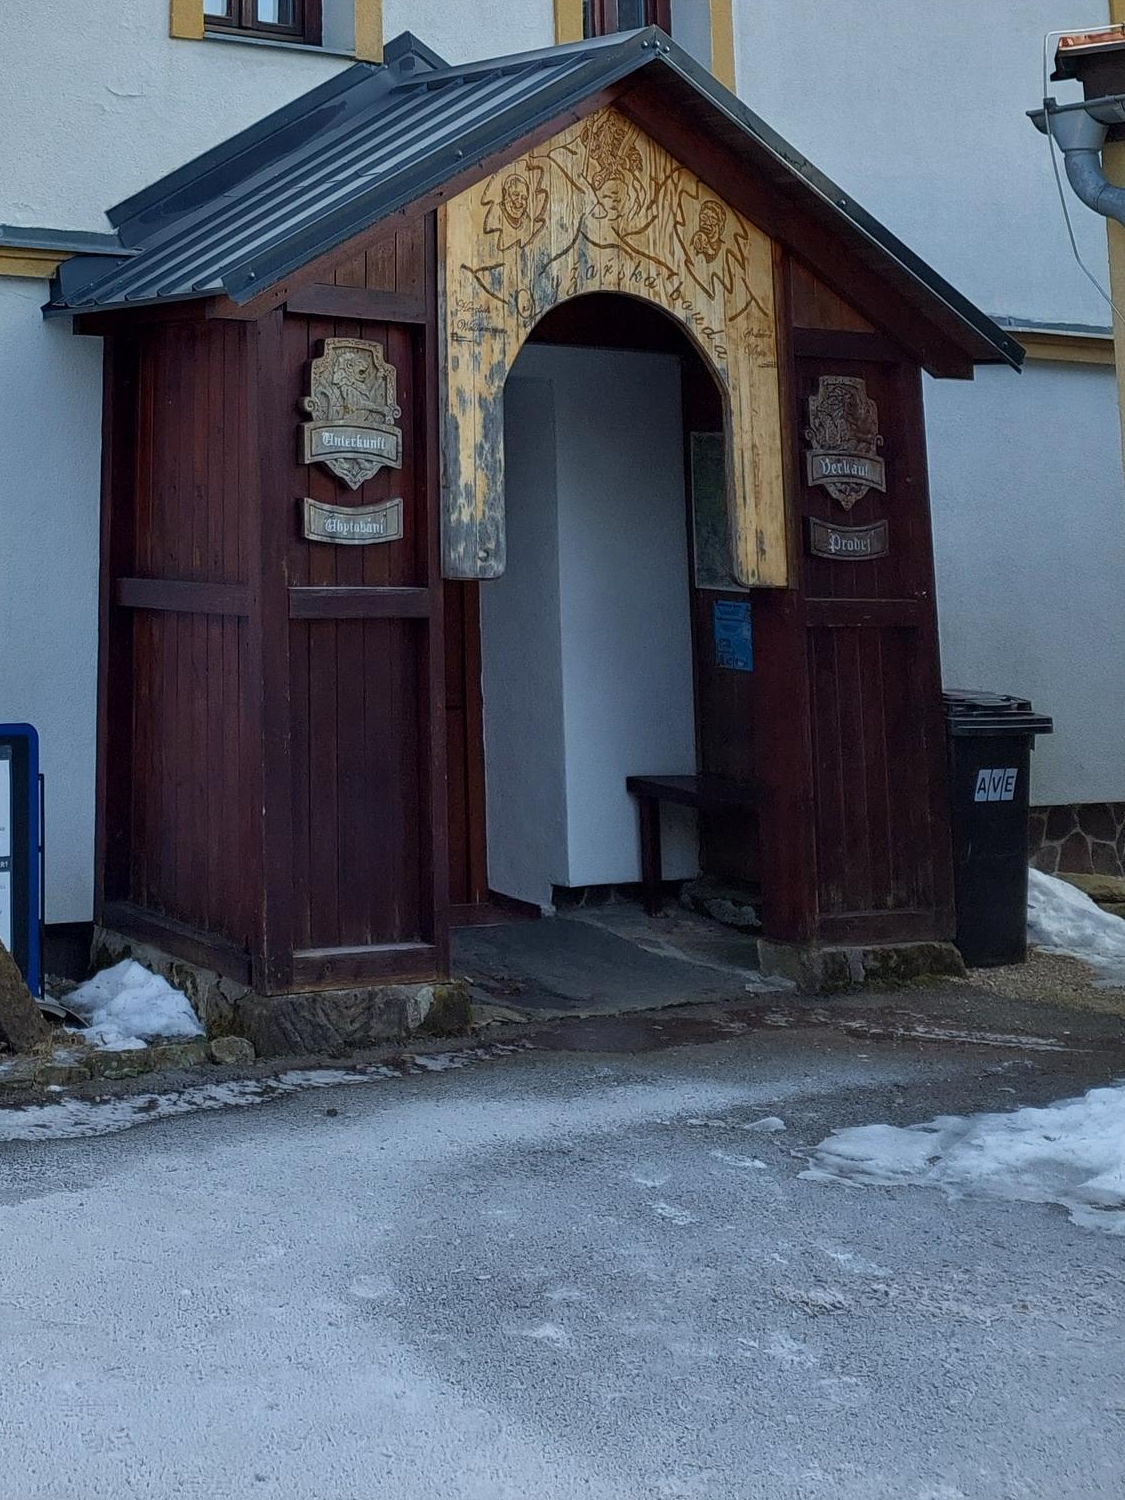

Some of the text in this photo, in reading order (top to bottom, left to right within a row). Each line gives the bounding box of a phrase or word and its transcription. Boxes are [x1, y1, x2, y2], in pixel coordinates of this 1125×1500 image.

[670, 280, 728, 360] bouda
[321, 431, 386, 450] Unterkunft
[819, 458, 869, 477] Verkauf
[324, 516, 384, 536] Ubytování
[828, 529, 871, 554] Prodej
[977, 775, 1016, 795] AVE
